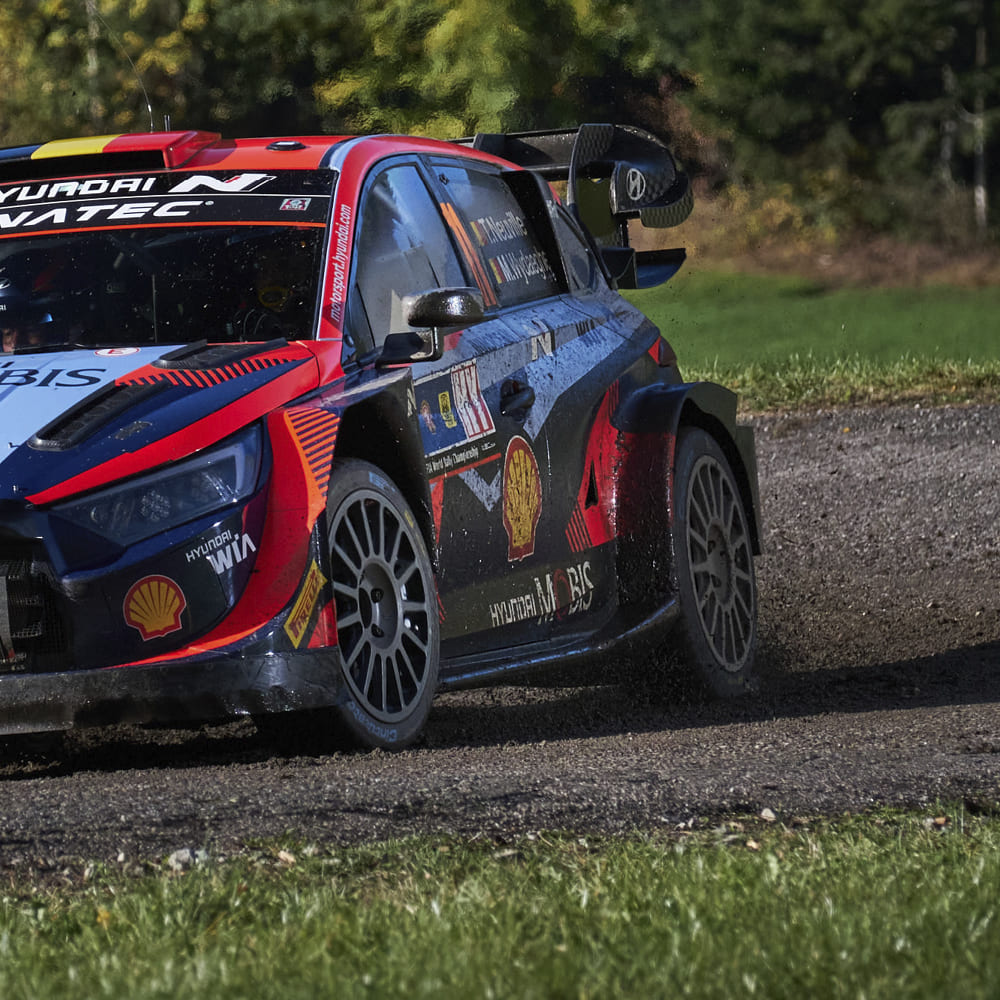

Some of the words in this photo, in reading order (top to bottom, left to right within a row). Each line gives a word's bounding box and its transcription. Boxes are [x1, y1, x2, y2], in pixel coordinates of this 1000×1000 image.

[330, 204, 352, 322] motorsport.hyundai.com
[185, 529, 232, 562] HYUNDAI
[489, 592, 536, 627] HYUNDAI
[534, 560, 594, 624] MOBIS
